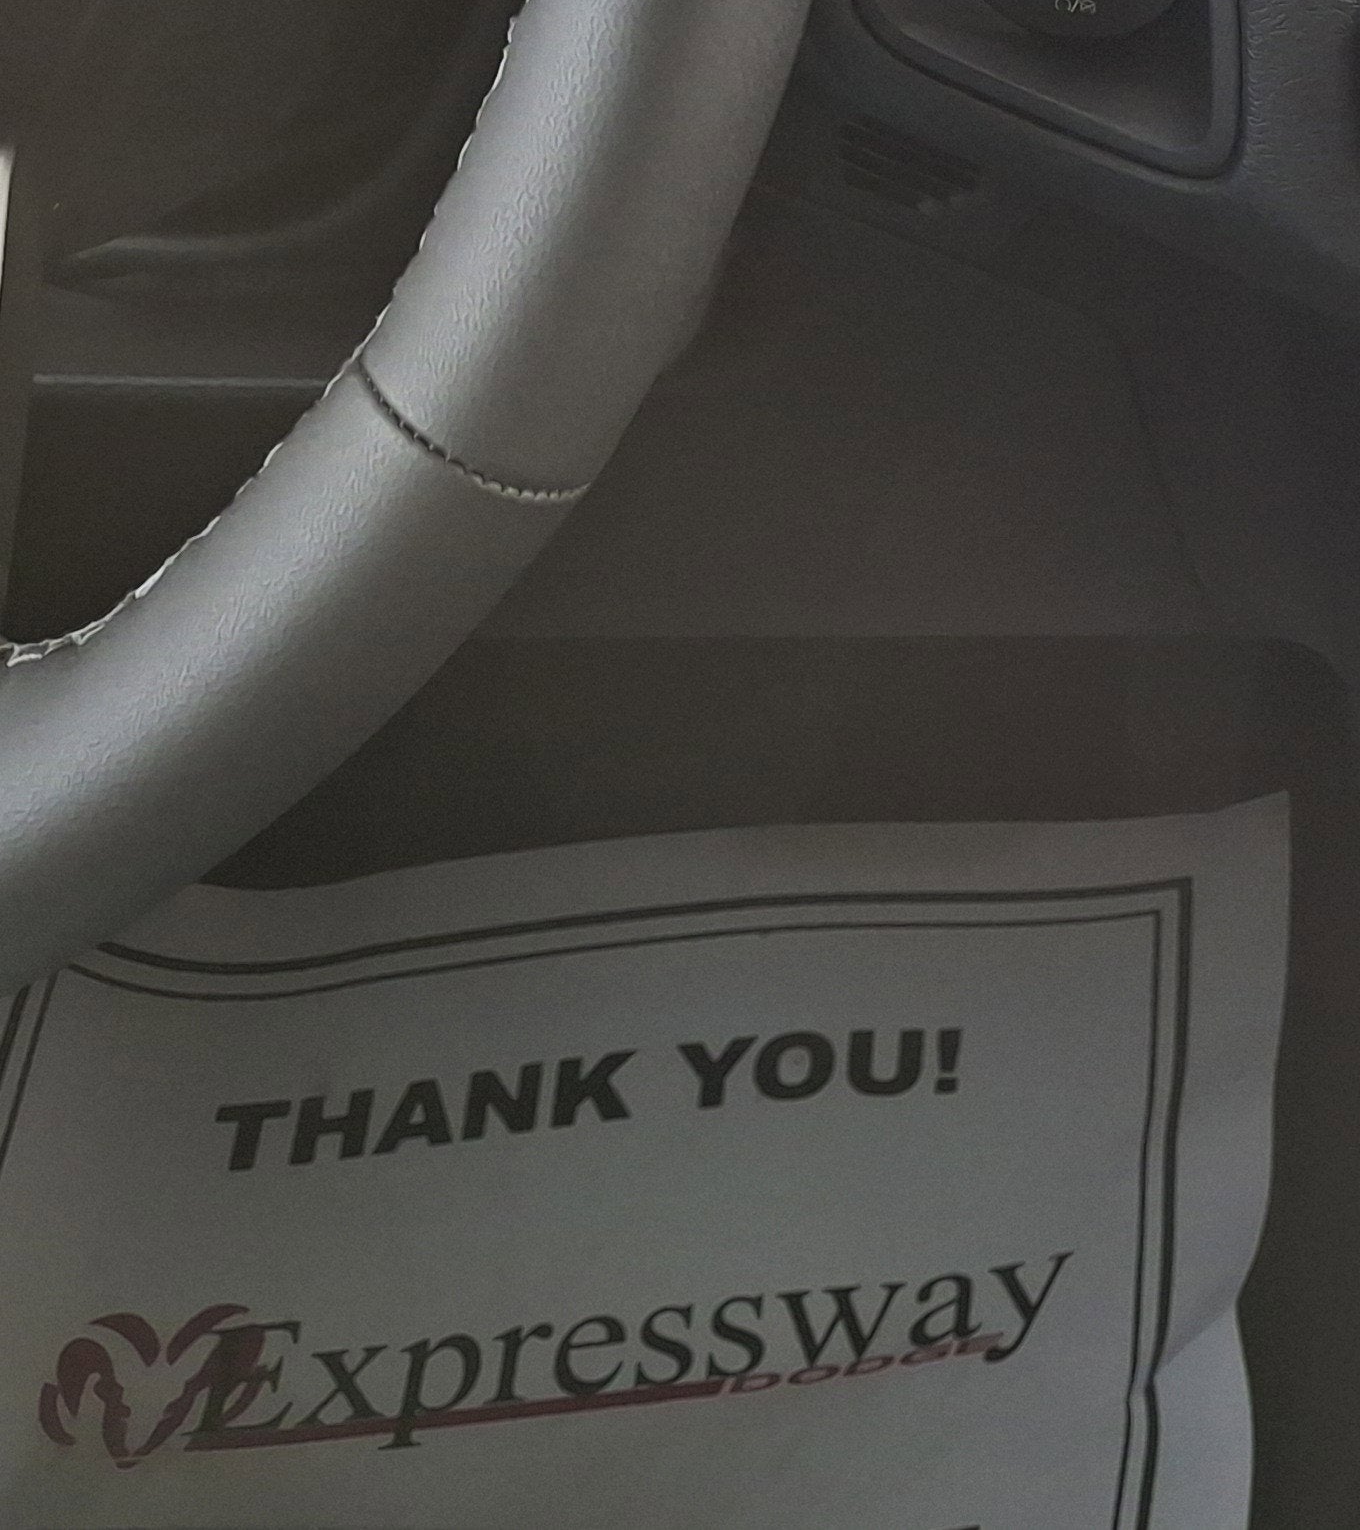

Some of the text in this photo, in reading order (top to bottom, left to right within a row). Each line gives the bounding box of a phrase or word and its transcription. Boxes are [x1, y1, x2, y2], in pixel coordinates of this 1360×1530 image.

[213, 1026, 964, 1173] THANK YOU!
[182, 1251, 1075, 1451] Expressway
